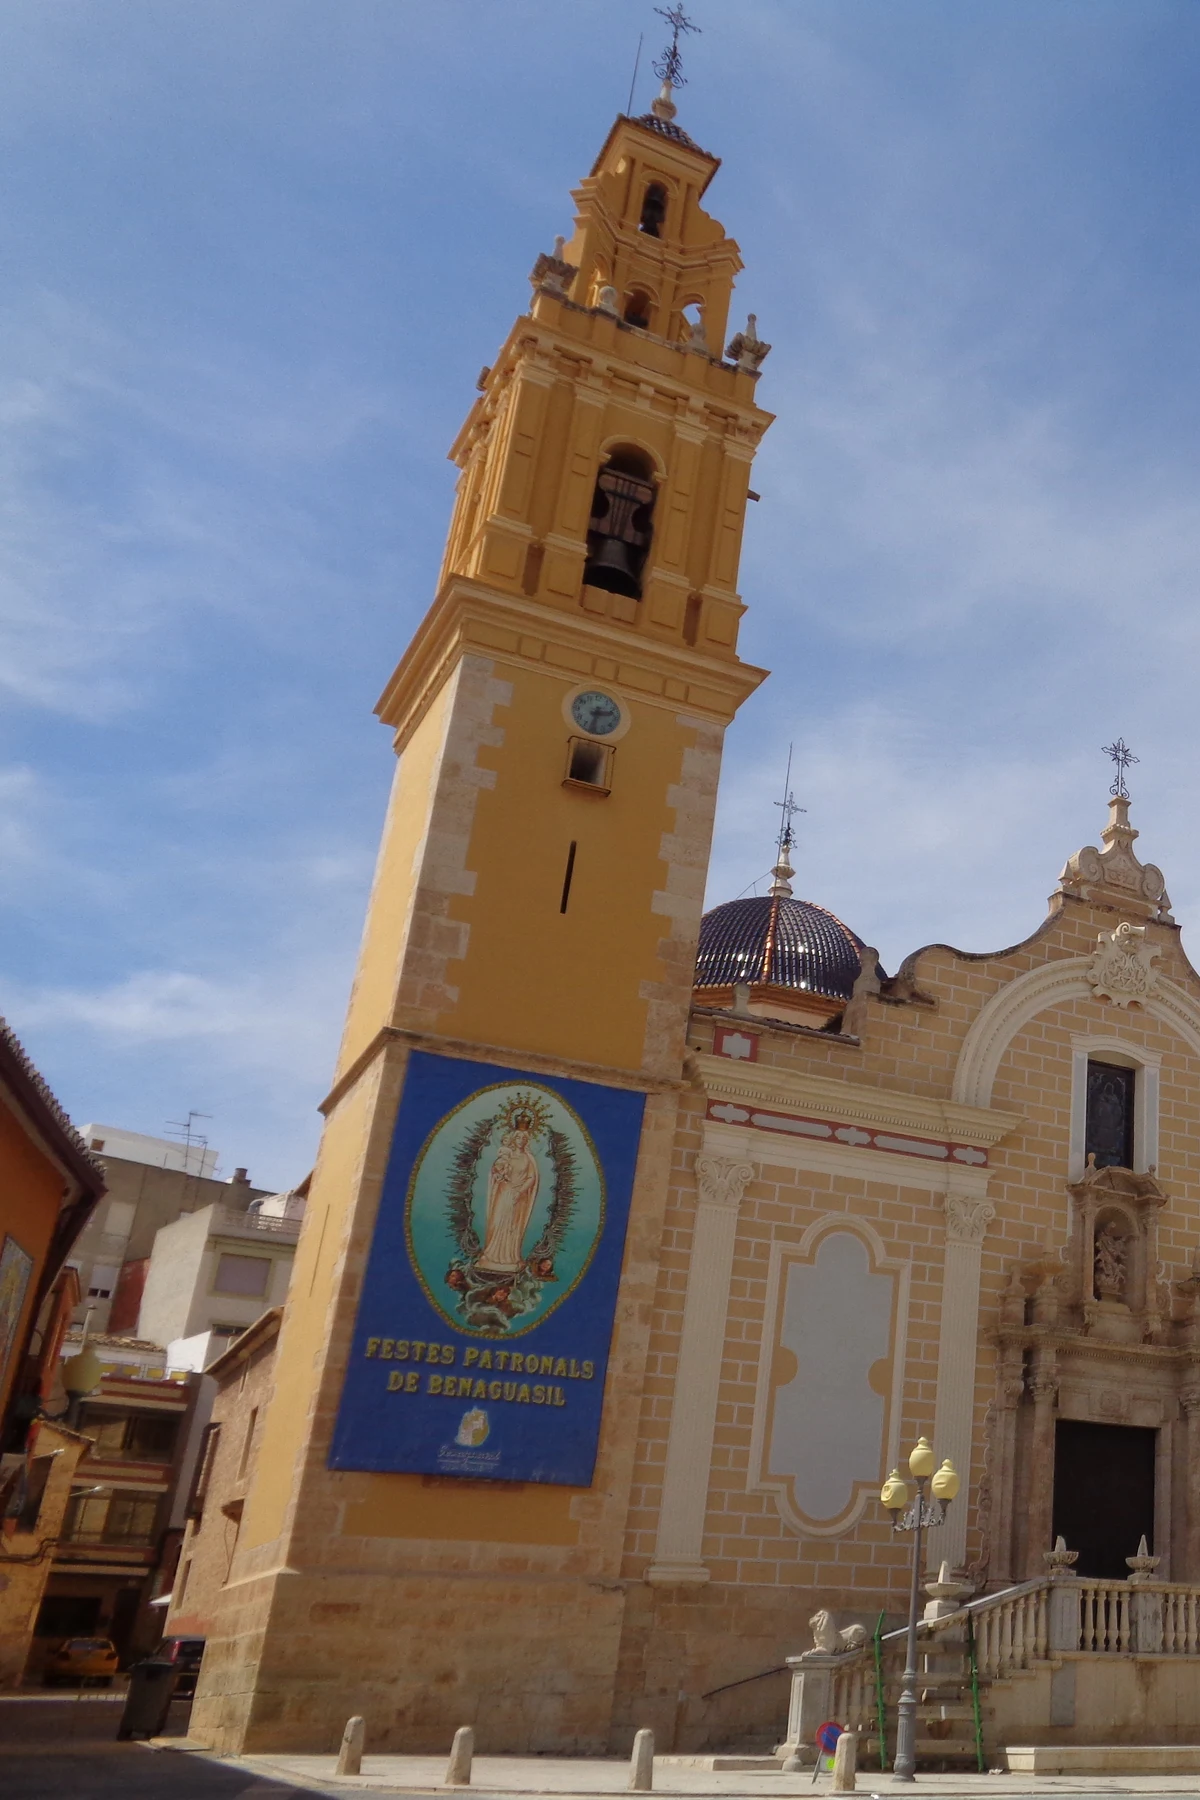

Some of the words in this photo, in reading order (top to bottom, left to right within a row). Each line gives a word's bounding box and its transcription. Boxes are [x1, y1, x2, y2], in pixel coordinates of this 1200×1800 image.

[364, 1337, 457, 1365] FESTES
[462, 1346, 595, 1379] PATRONALS
[387, 1370, 419, 1393] DE
[426, 1373, 566, 1406] BENAGUASIL
